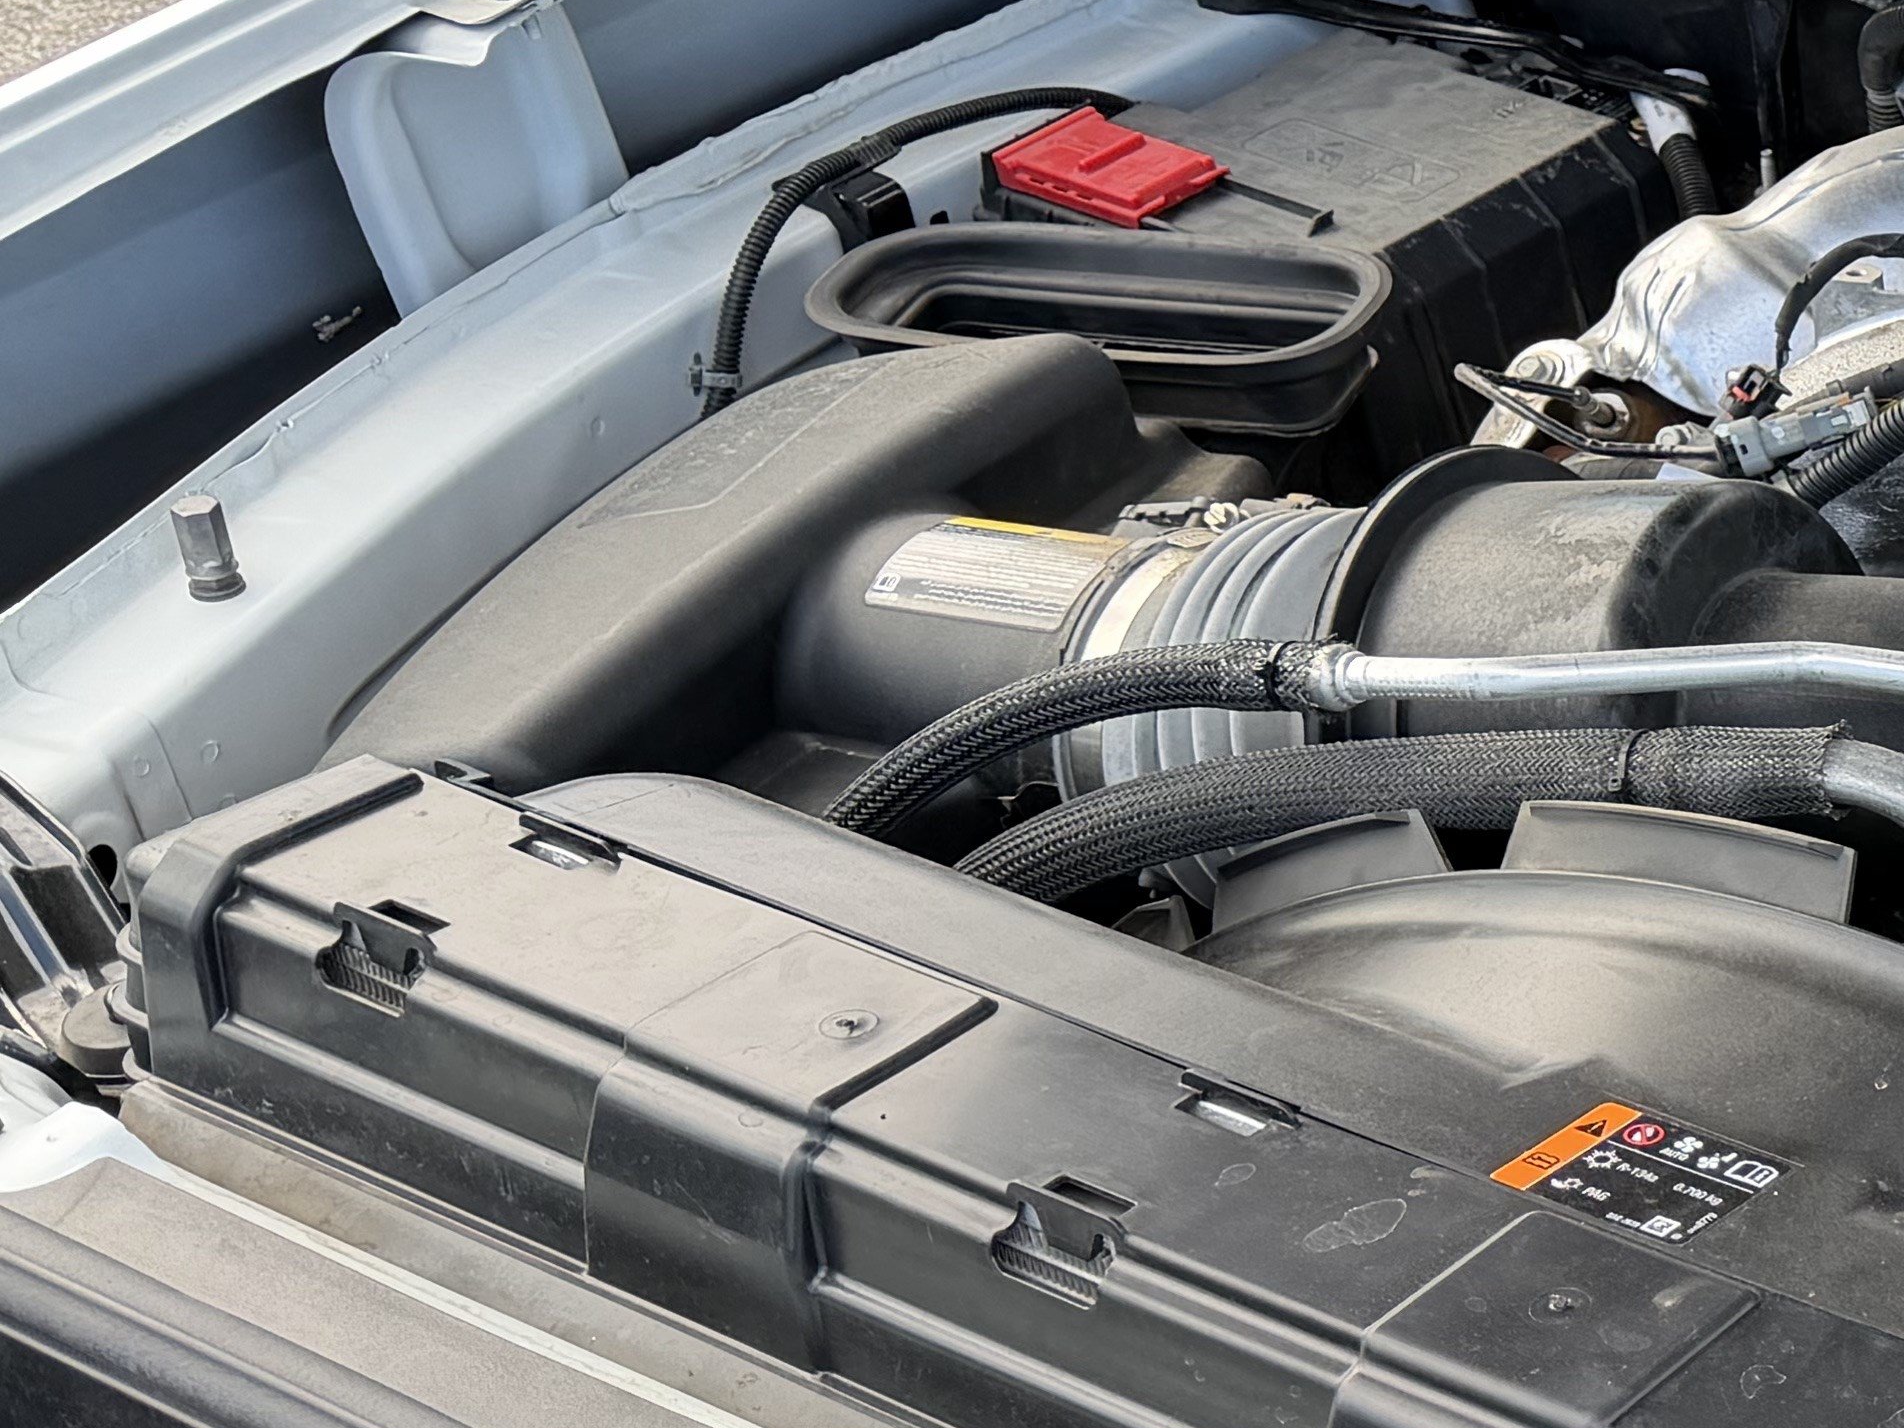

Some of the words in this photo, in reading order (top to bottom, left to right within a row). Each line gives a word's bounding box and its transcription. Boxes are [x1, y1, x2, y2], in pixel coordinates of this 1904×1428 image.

[1658, 1147, 1690, 1162] AUTO
[1615, 1162, 1659, 1183] R-134a
[1581, 1186, 1612, 1202] PAG
